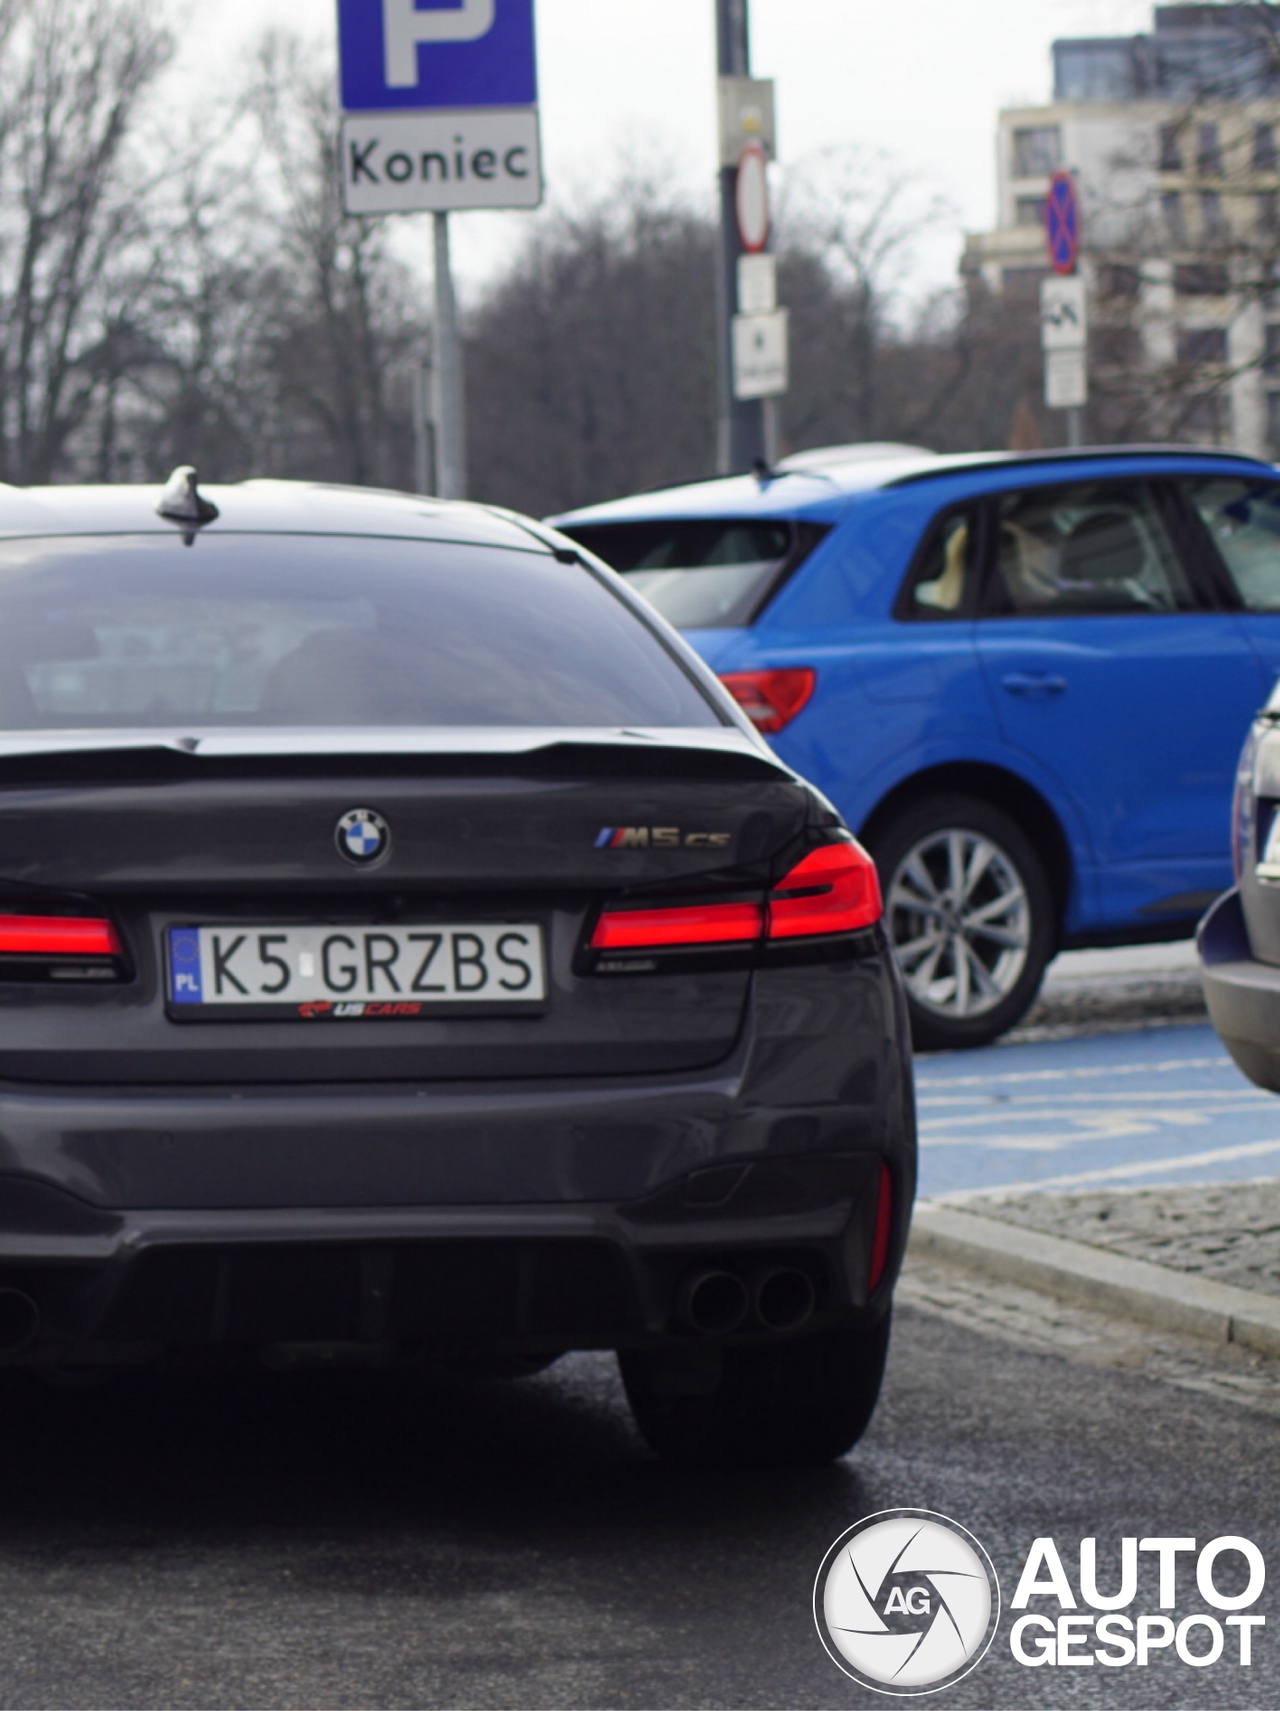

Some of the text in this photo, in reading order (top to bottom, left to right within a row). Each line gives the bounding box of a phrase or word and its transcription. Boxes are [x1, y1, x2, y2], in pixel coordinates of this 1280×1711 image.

[382, 0, 496, 88] P
[350, 134, 529, 184] Koniec
[176, 975, 198, 991] PL
[212, 932, 533, 995] K5 GRZBS
